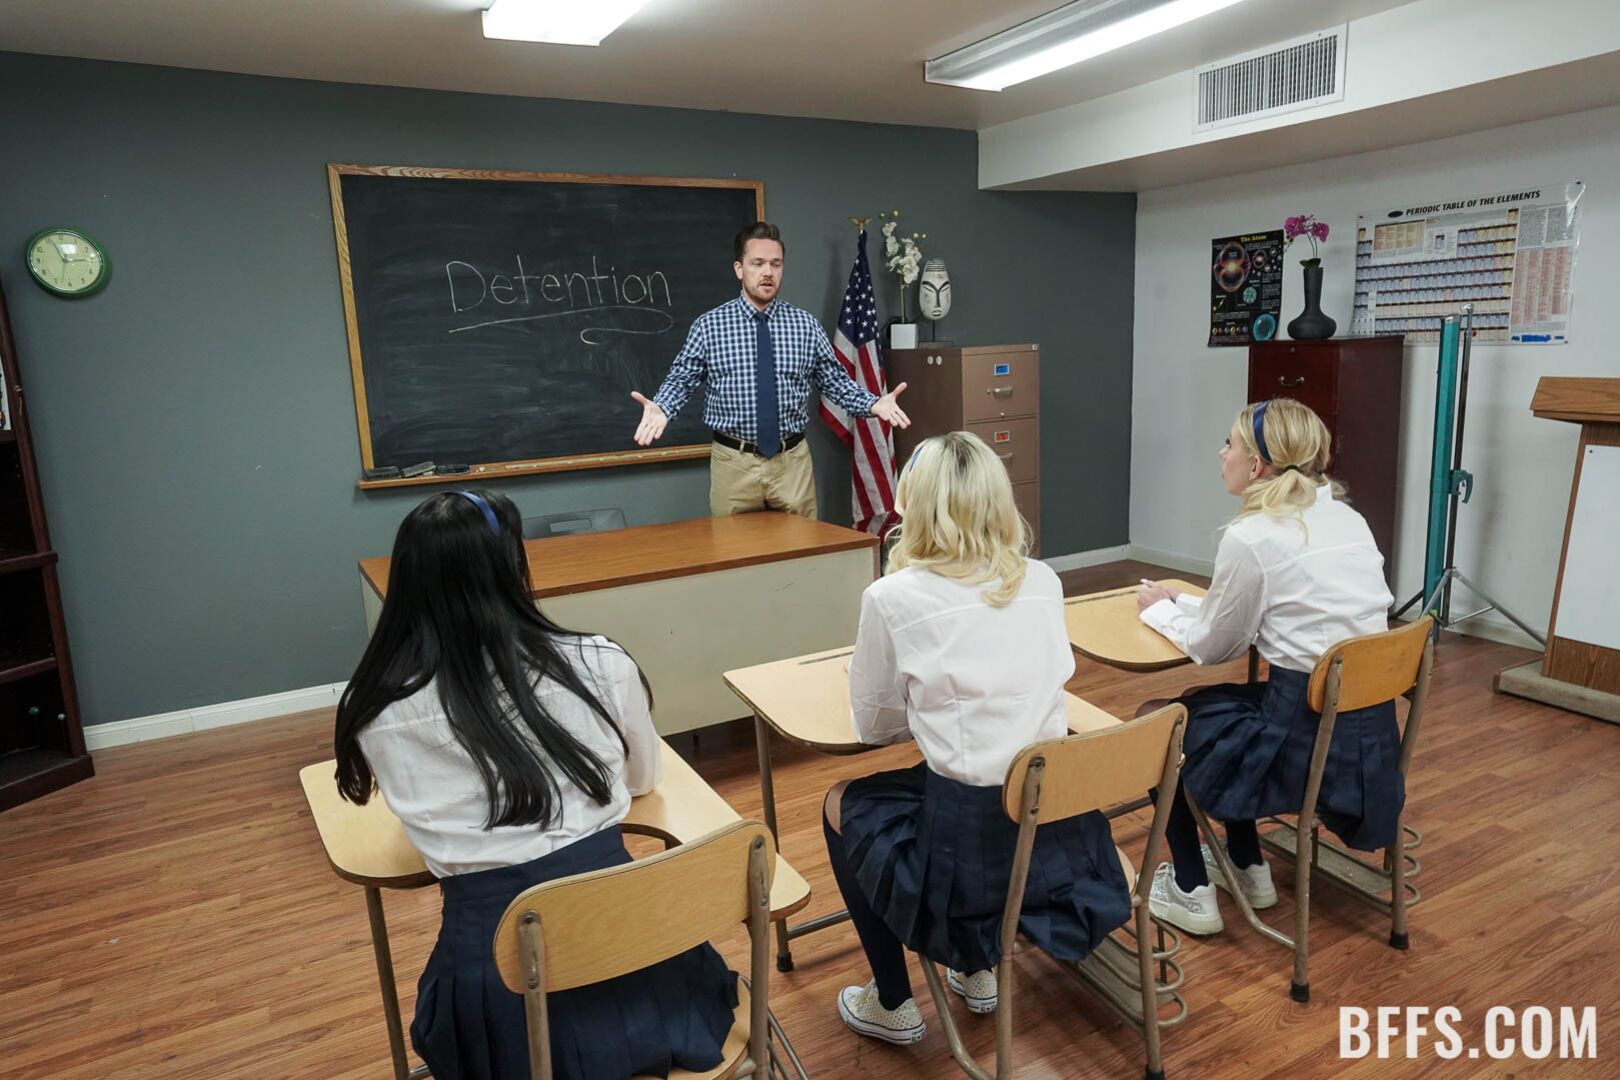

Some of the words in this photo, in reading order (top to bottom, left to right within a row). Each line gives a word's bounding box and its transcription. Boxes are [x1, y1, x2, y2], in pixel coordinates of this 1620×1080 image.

[1406, 204, 1440, 216] PERIODIC
[1442, 201, 1465, 211] TABLE
[1467, 199, 1477, 208] OF
[1479, 197, 1495, 206] THE
[1497, 190, 1541, 204] ELEMENTS
[446, 254, 672, 313] Detention
